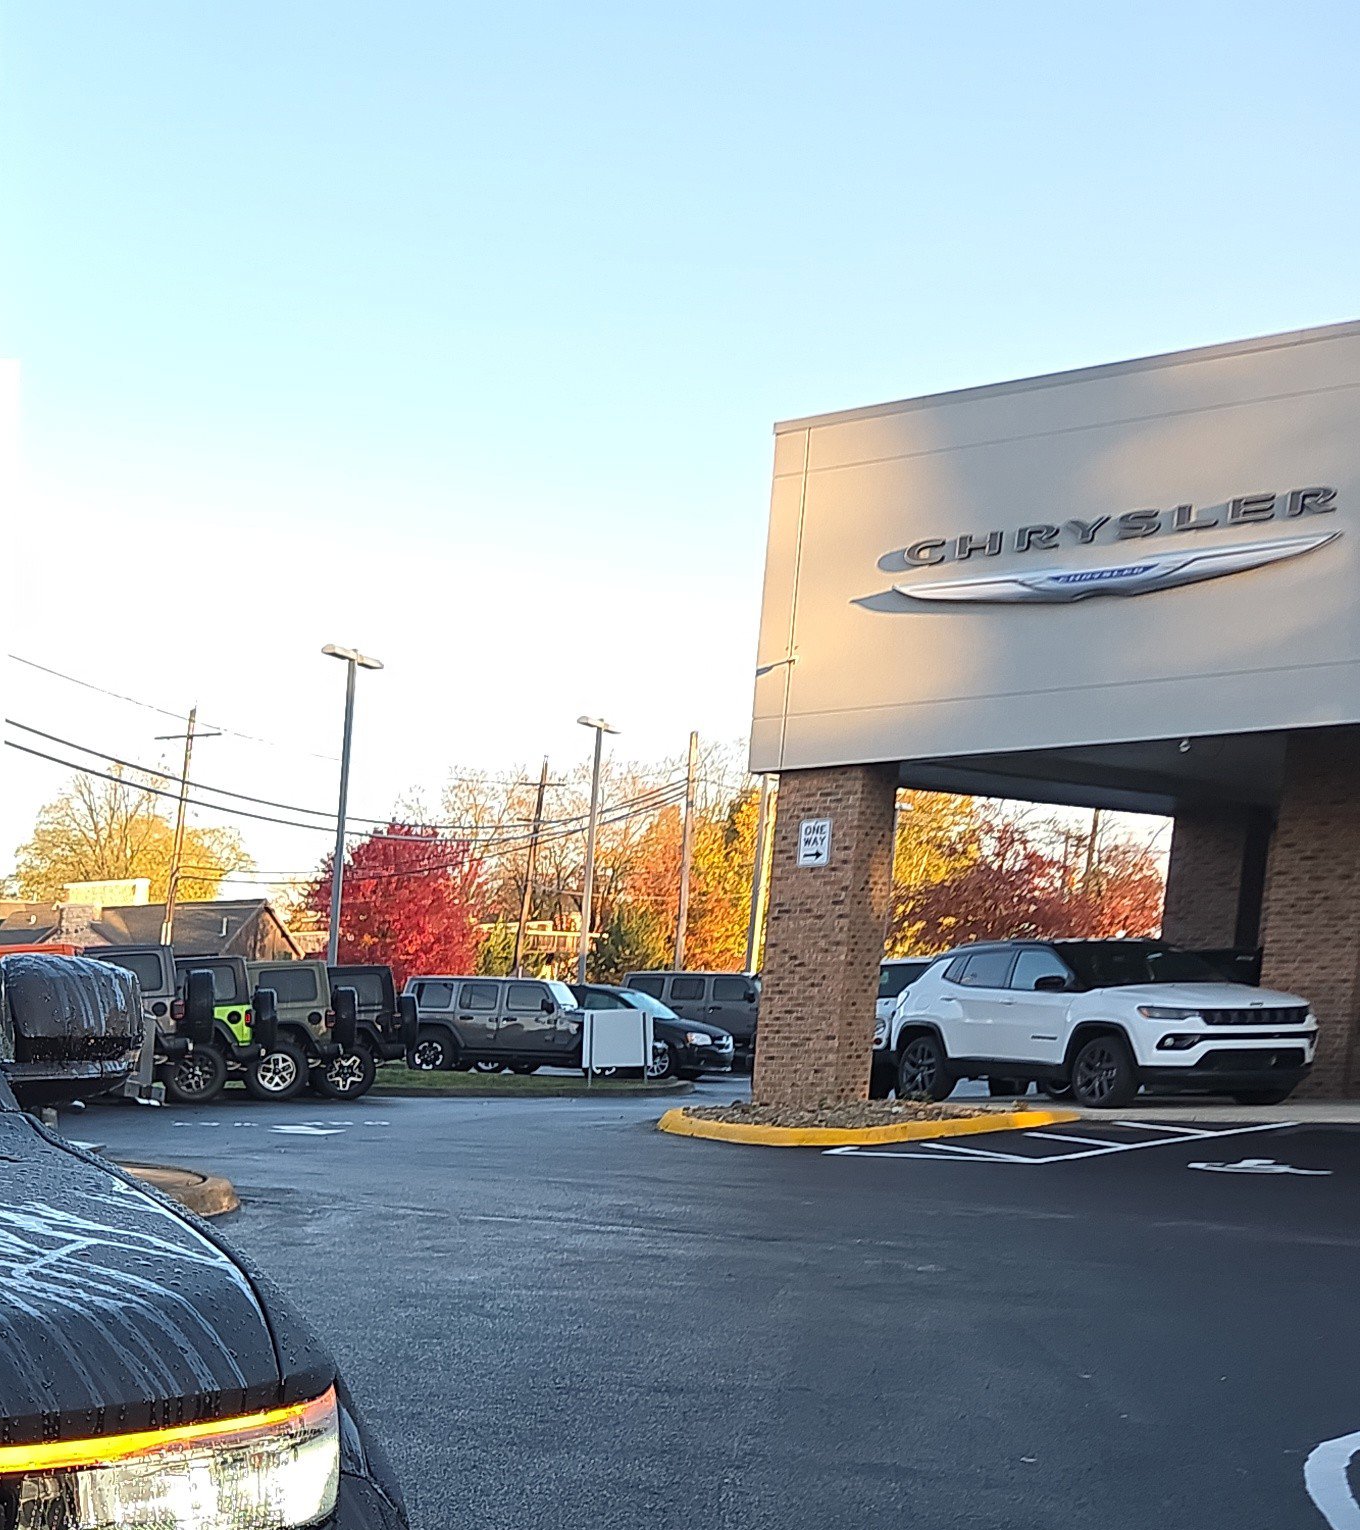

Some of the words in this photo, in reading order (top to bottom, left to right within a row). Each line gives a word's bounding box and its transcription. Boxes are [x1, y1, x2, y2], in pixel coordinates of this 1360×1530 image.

[902, 485, 1340, 567] CHRYSLER
[804, 824, 827, 836] ONE
[803, 836, 826, 847] WAY
